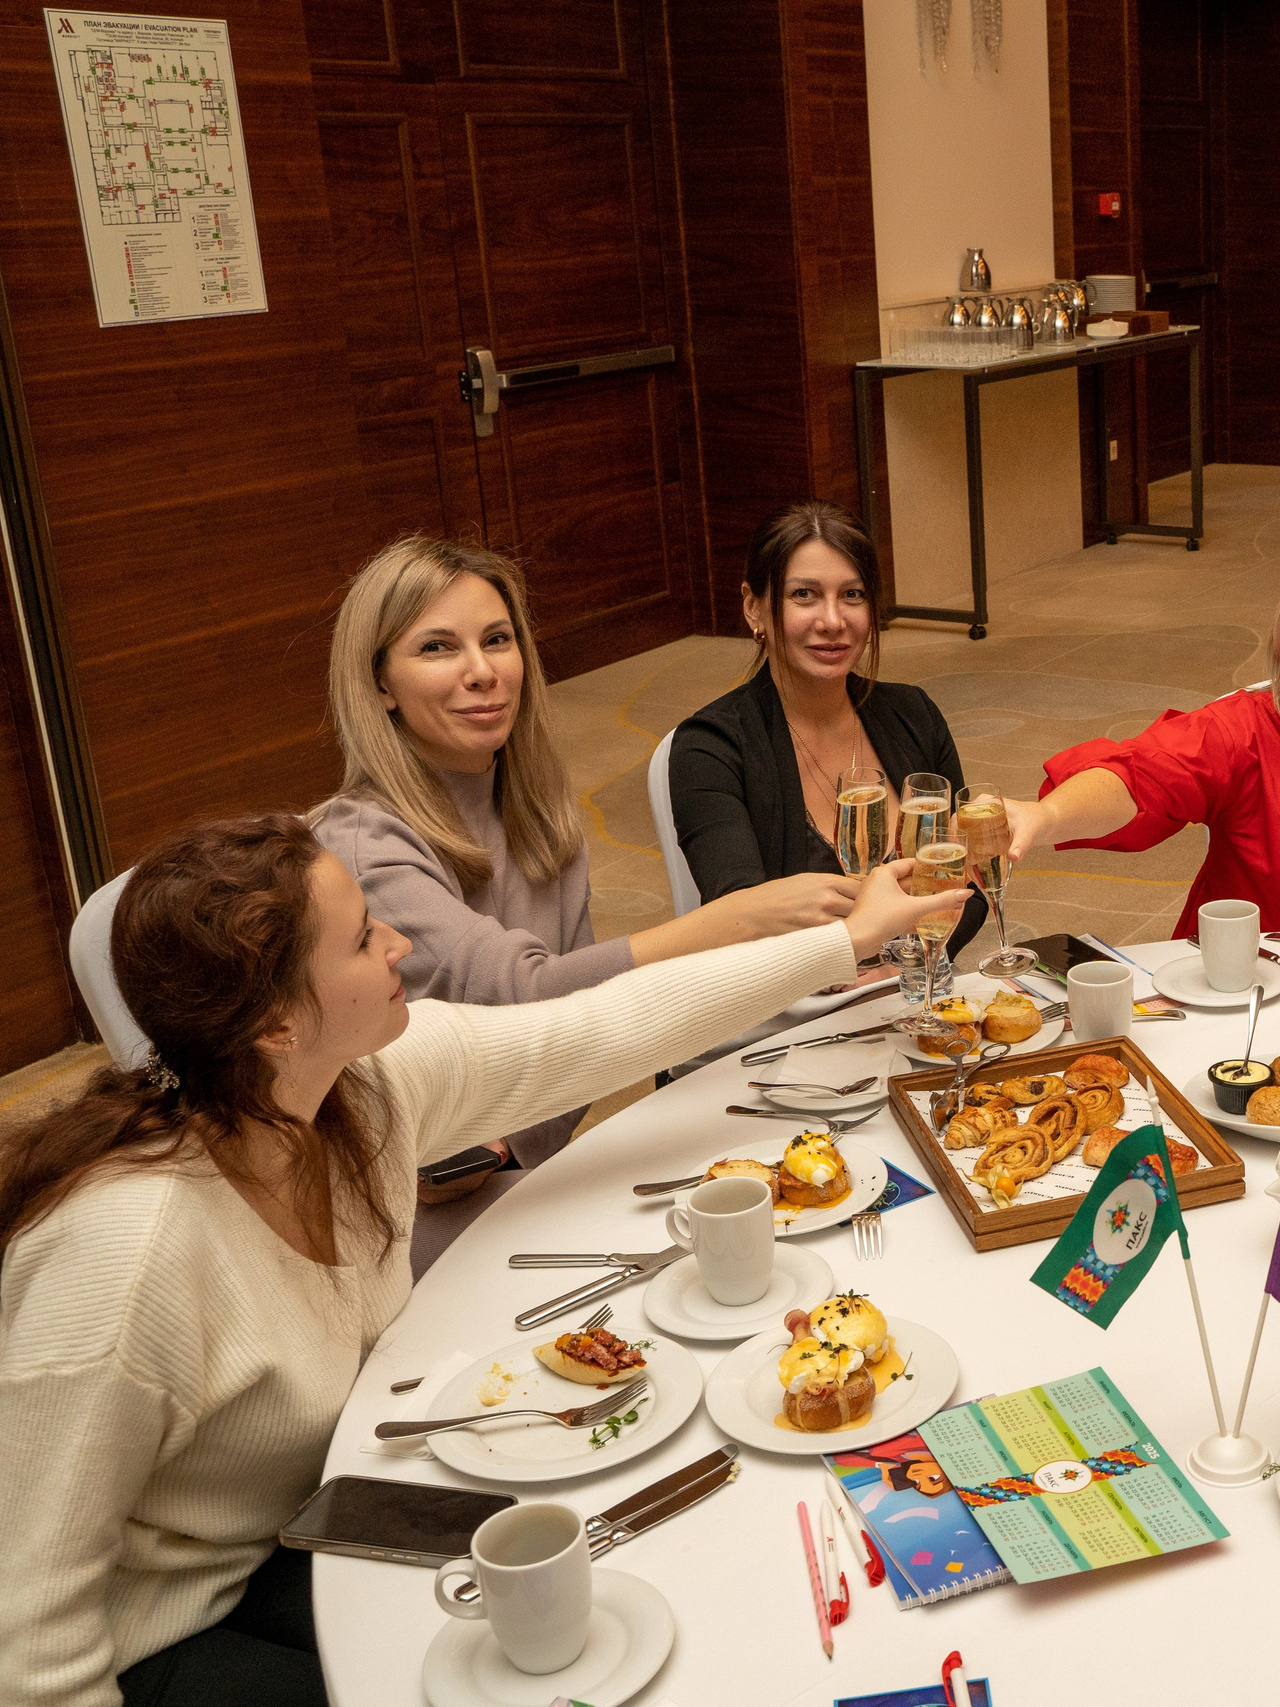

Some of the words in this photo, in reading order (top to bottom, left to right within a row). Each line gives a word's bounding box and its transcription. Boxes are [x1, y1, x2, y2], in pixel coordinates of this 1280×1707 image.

[103, 22, 140, 30] ЭВАКУАЦИИ
[144, 24, 181, 32] EVACUATION
[1126, 1212, 1147, 1250] ПАКС
[1140, 1442, 1161, 1459] 2025
[1042, 1471, 1060, 1488] ПАКС
